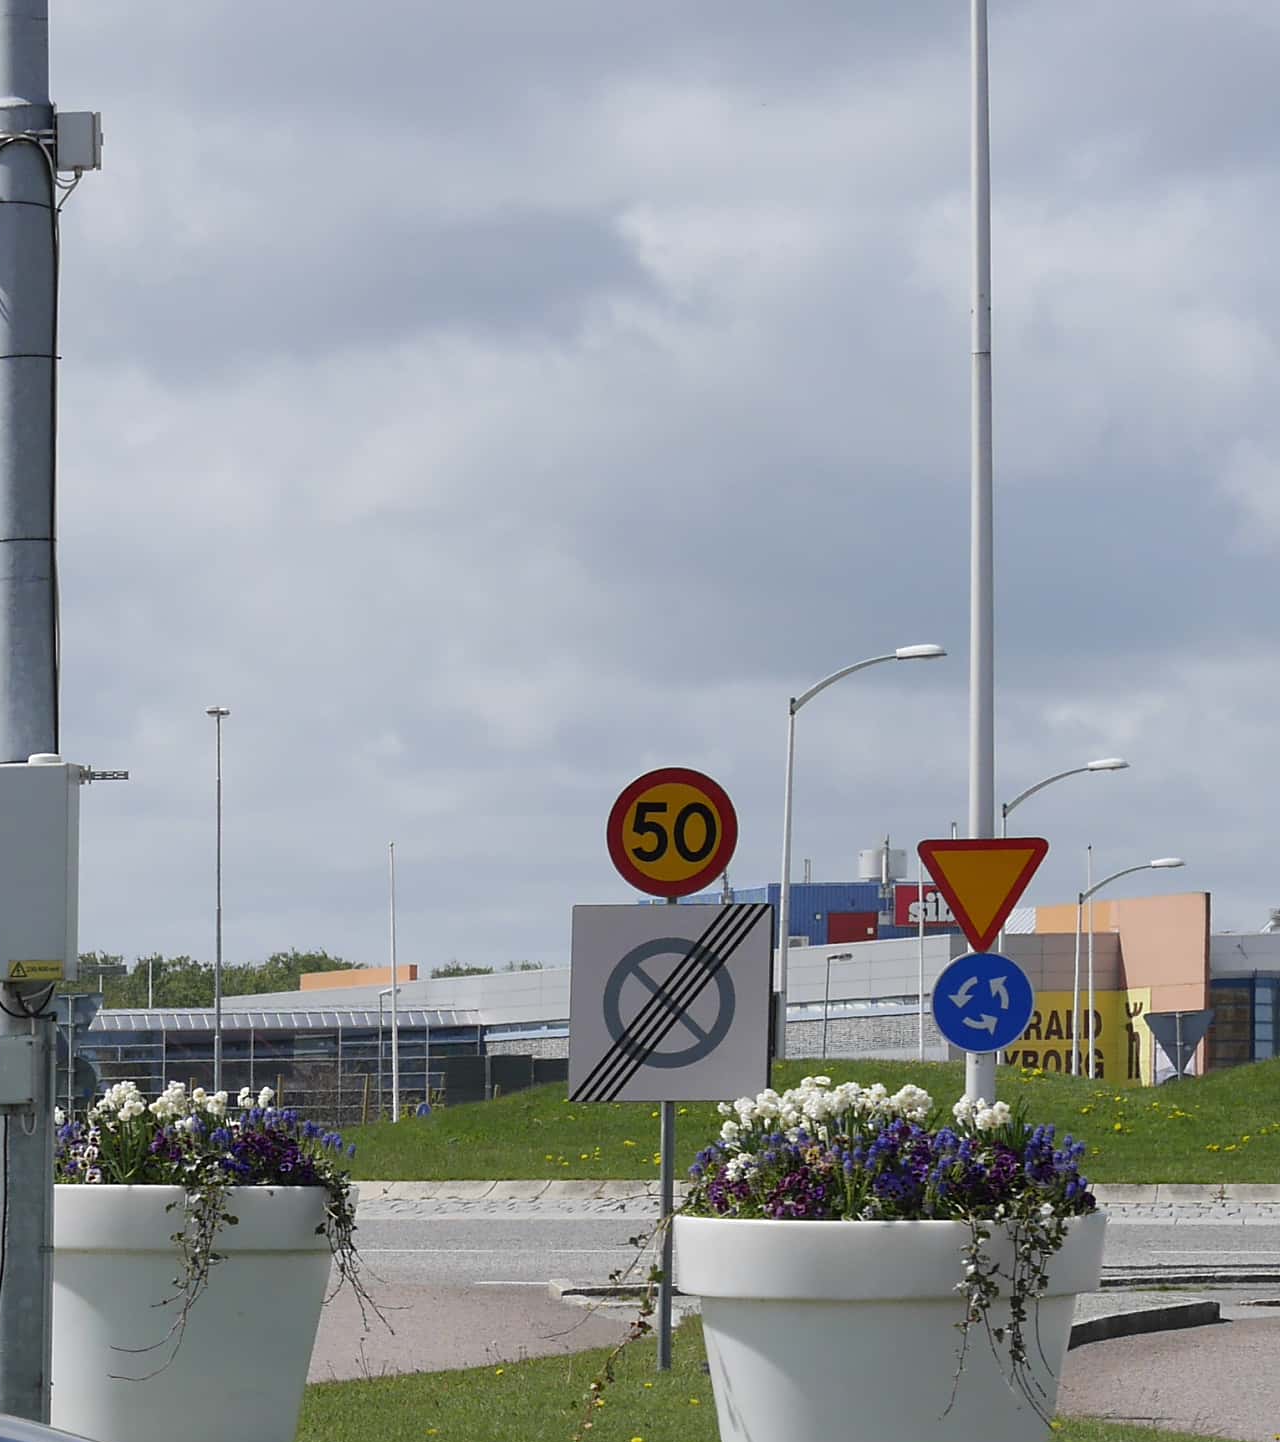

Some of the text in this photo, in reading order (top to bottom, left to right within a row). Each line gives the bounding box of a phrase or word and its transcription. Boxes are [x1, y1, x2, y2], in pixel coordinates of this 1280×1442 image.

[632, 802, 717, 862] 50
[908, 892, 957, 922] sib
[1018, 1009, 1103, 1041] RALD
